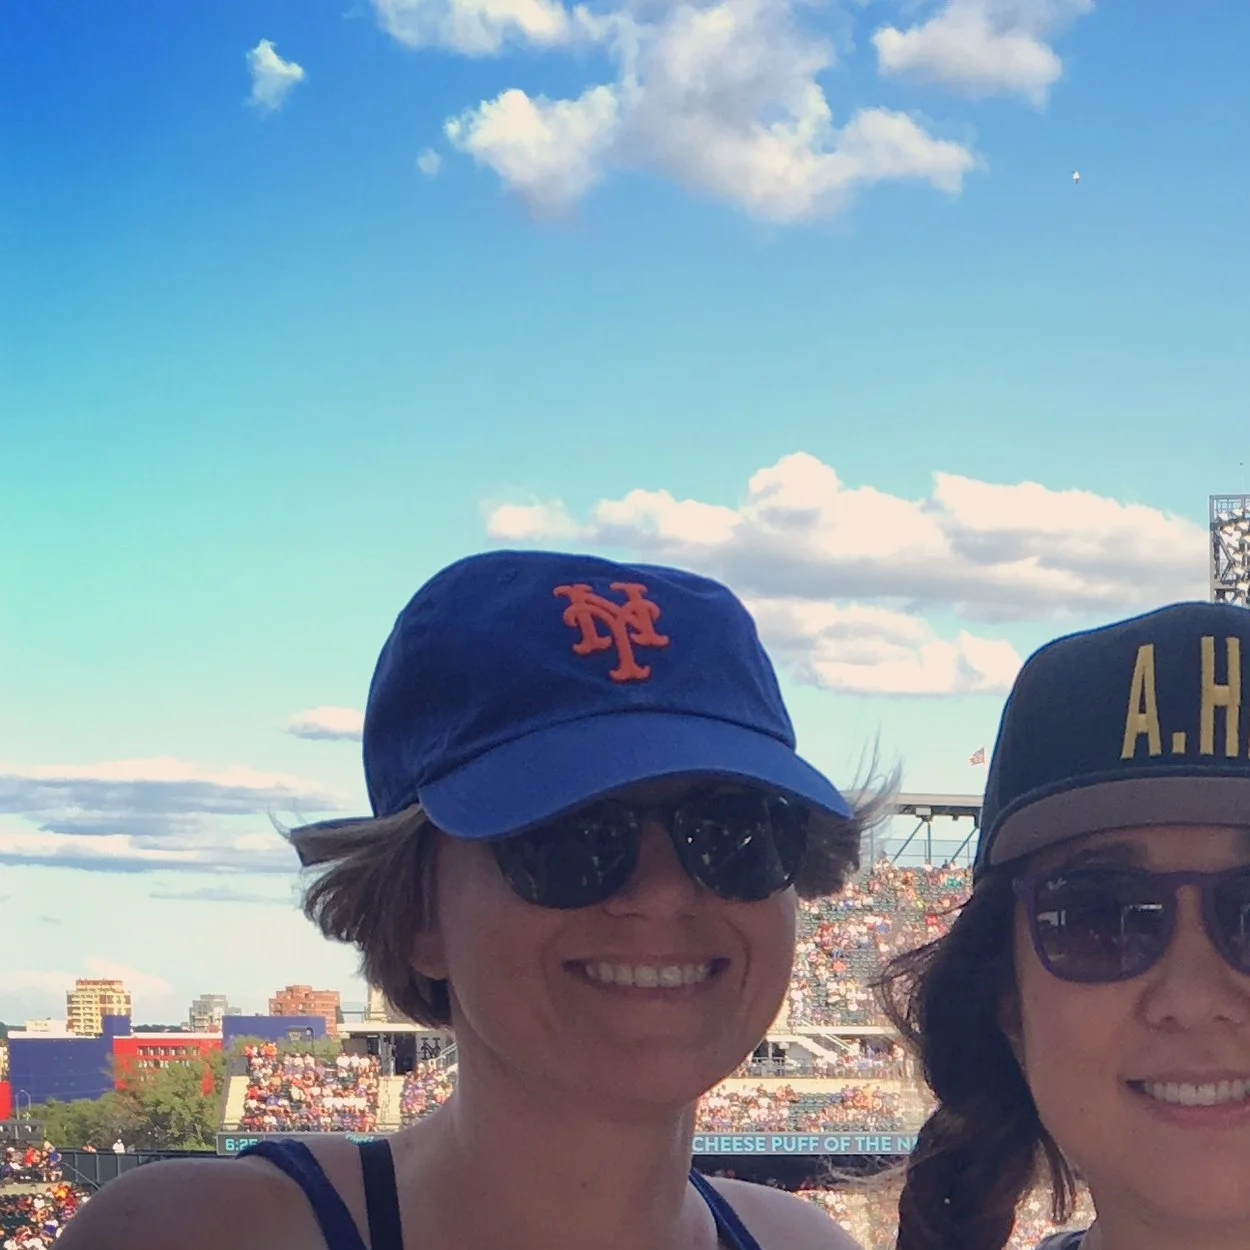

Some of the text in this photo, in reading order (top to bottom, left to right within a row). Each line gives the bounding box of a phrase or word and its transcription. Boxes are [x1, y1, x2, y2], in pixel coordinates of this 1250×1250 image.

[691, 1136, 766, 1152] CHEESE
[771, 1136, 820, 1152] PUFF
[823, 1136, 850, 1152] OF
[854, 1136, 891, 1152] THE
